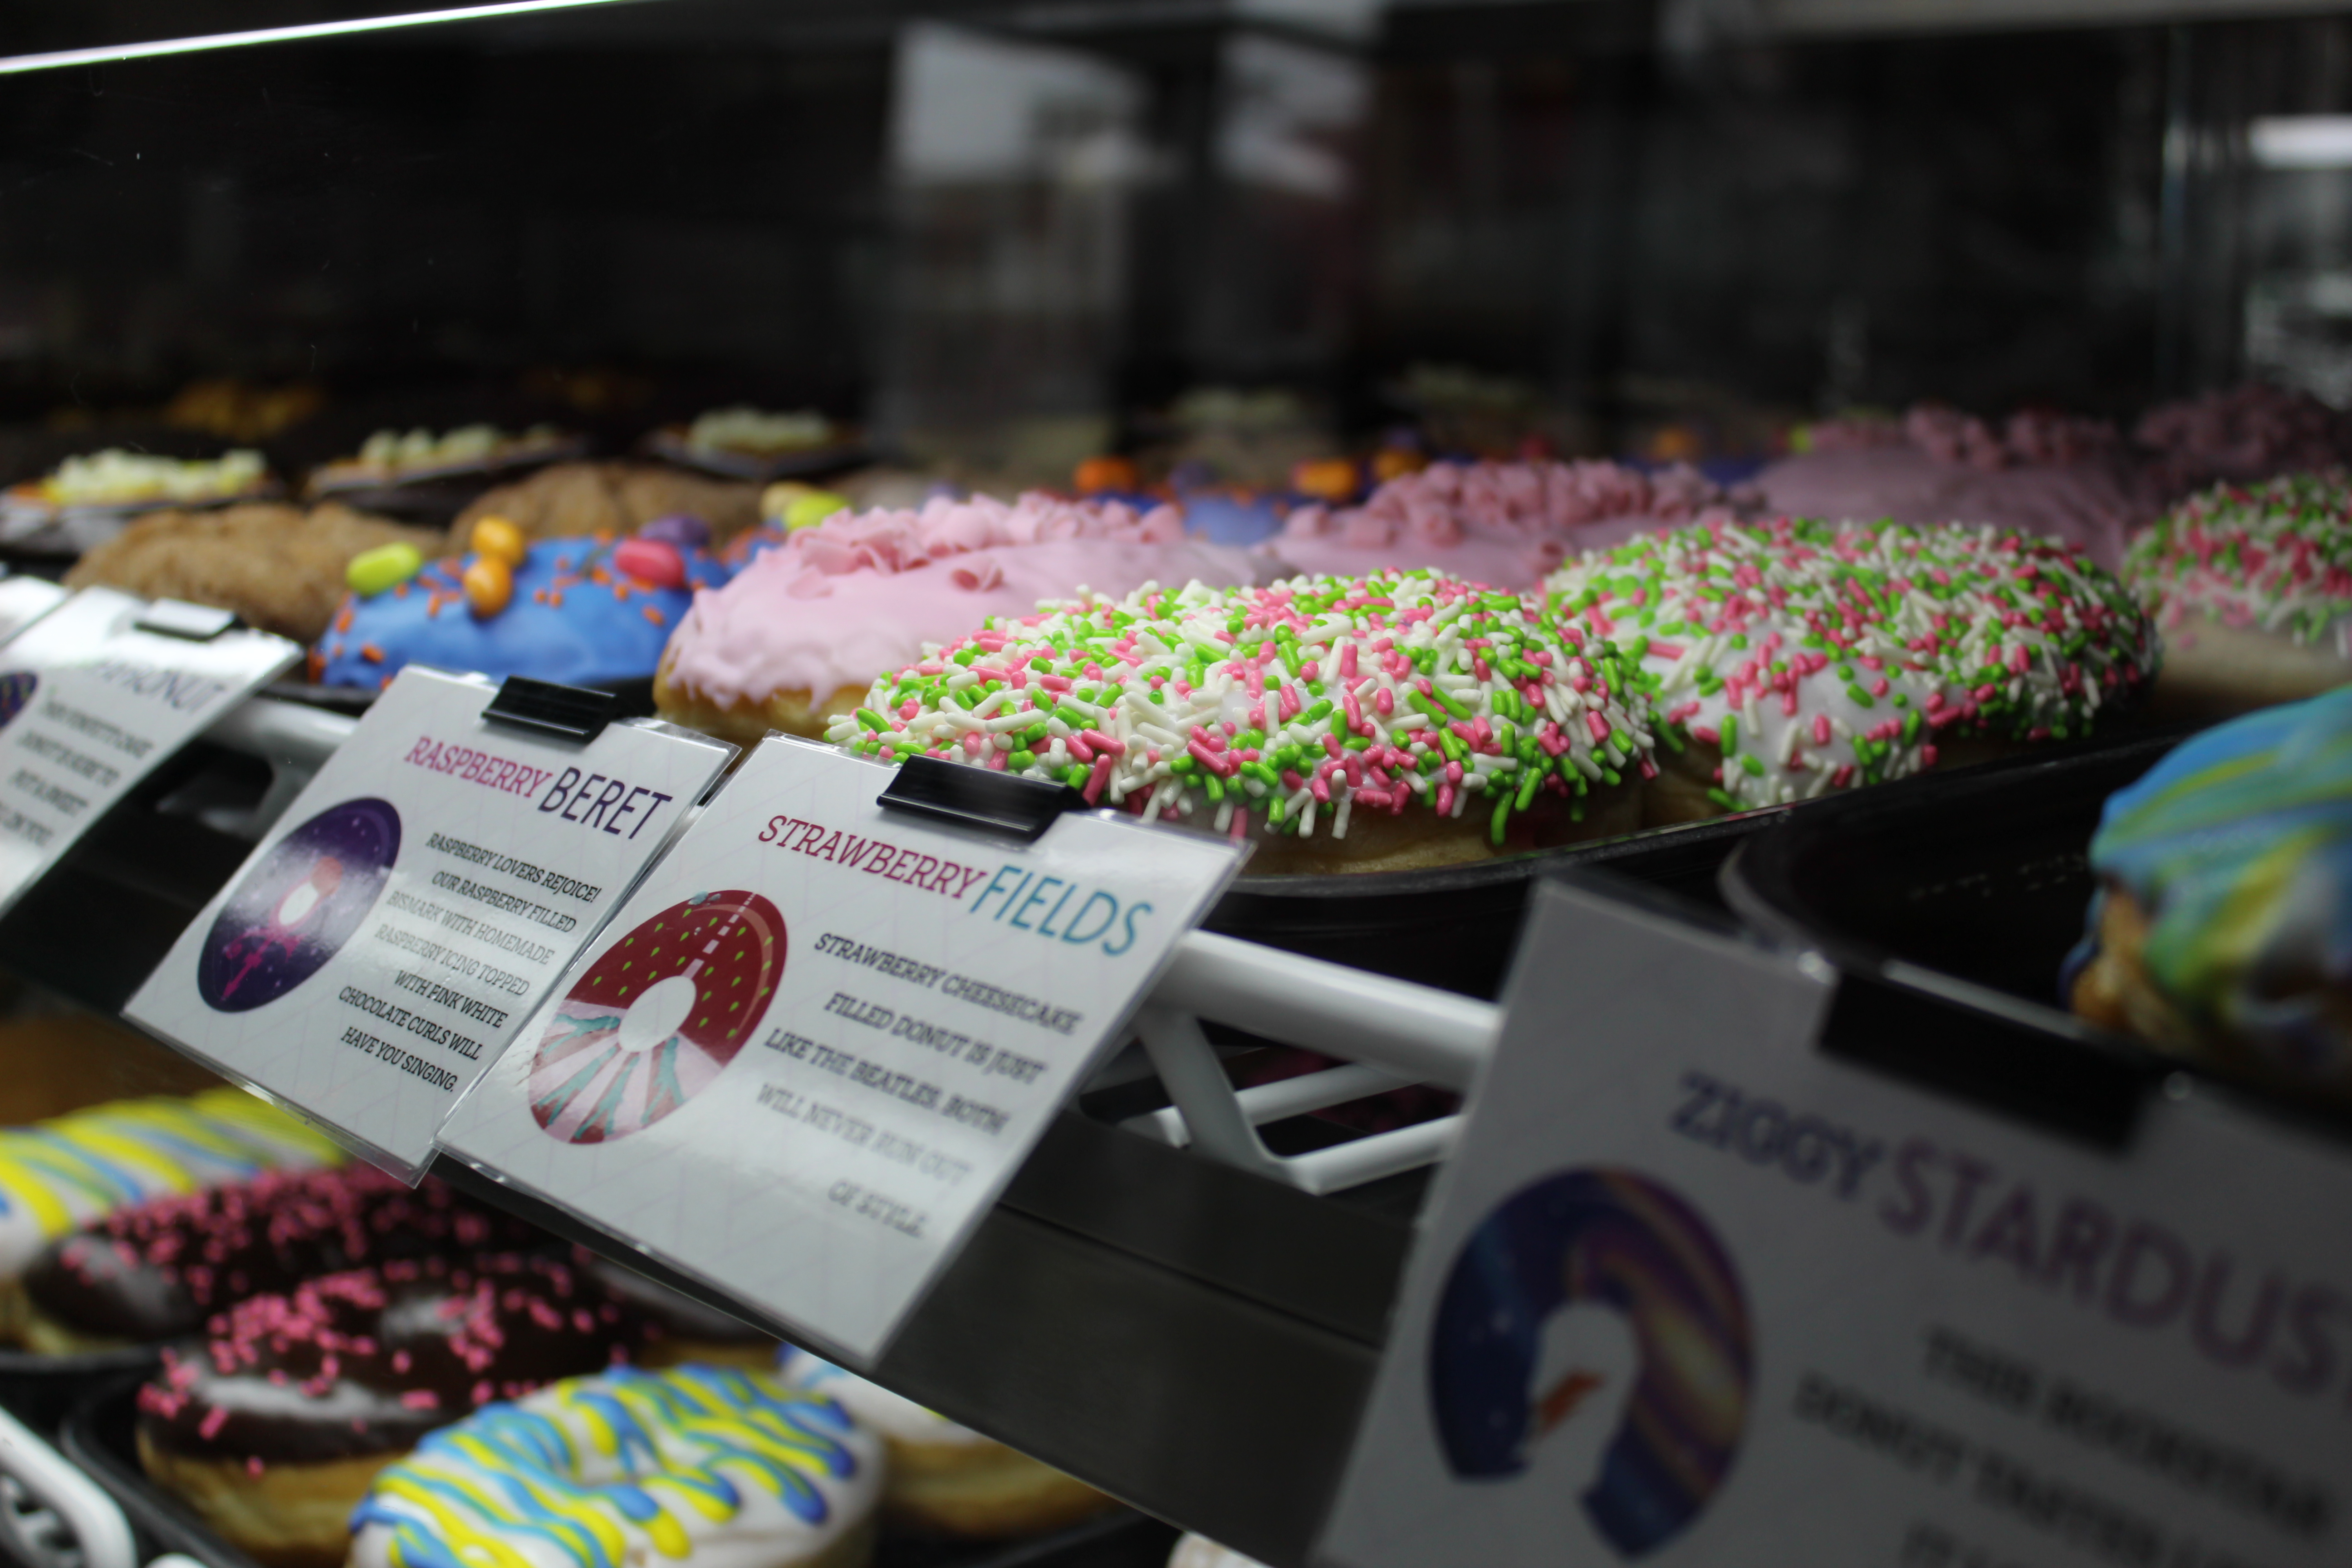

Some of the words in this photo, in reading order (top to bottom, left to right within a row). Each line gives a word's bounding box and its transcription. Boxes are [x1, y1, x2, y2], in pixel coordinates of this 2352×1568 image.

[406, 737, 551, 797] RASPBERRY
[539, 767, 671, 838] BERET
[427, 834, 496, 866] RASPBERRY
[494, 856, 544, 882] LOVERS
[542, 873, 601, 902] REJOICE!
[433, 872, 459, 888] OUR
[458, 881, 531, 914] RASPBERRY
[529, 906, 576, 931] FILLED
[759, 815, 987, 899] STRAWBERRY
[970, 865, 1153, 956] FIELDS
[376, 925, 446, 960] RASPBERRY
[441, 949, 478, 974] ICING
[479, 966, 529, 994] TOPPED
[388, 892, 442, 921] BISMARK
[442, 911, 477, 934] WITH
[475, 925, 554, 964] HOMEMADE
[396, 970, 431, 994] WITH
[461, 998, 507, 1027] WHITE
[815, 934, 944, 988] STRAWBERRY
[941, 974, 1082, 1034] CHEESECAKE
[340, 987, 410, 1026] CHOCOLATE
[408, 1017, 450, 1043] CURLS
[450, 1034, 481, 1059] WILL
[342, 1028, 378, 1052] HAVE
[376, 1043, 405, 1063] YOU
[825, 992, 894, 1029] FILLED
[892, 1015, 968, 1056] DONUT
[963, 1037, 990, 1064] IS
[983, 1050, 1045, 1083] JUST
[758, 1083, 804, 1117] WILL
[803, 1102, 874, 1146] NEVER
[765, 1028, 812, 1058] LIKE
[809, 1045, 854, 1076] THE
[942, 1093, 1009, 1133] BOTH
[828, 1179, 861, 1205] OF
[1668, 1068, 1884, 1202] ZIGGY
[1877, 1131, 2352, 1417] STARDUS
